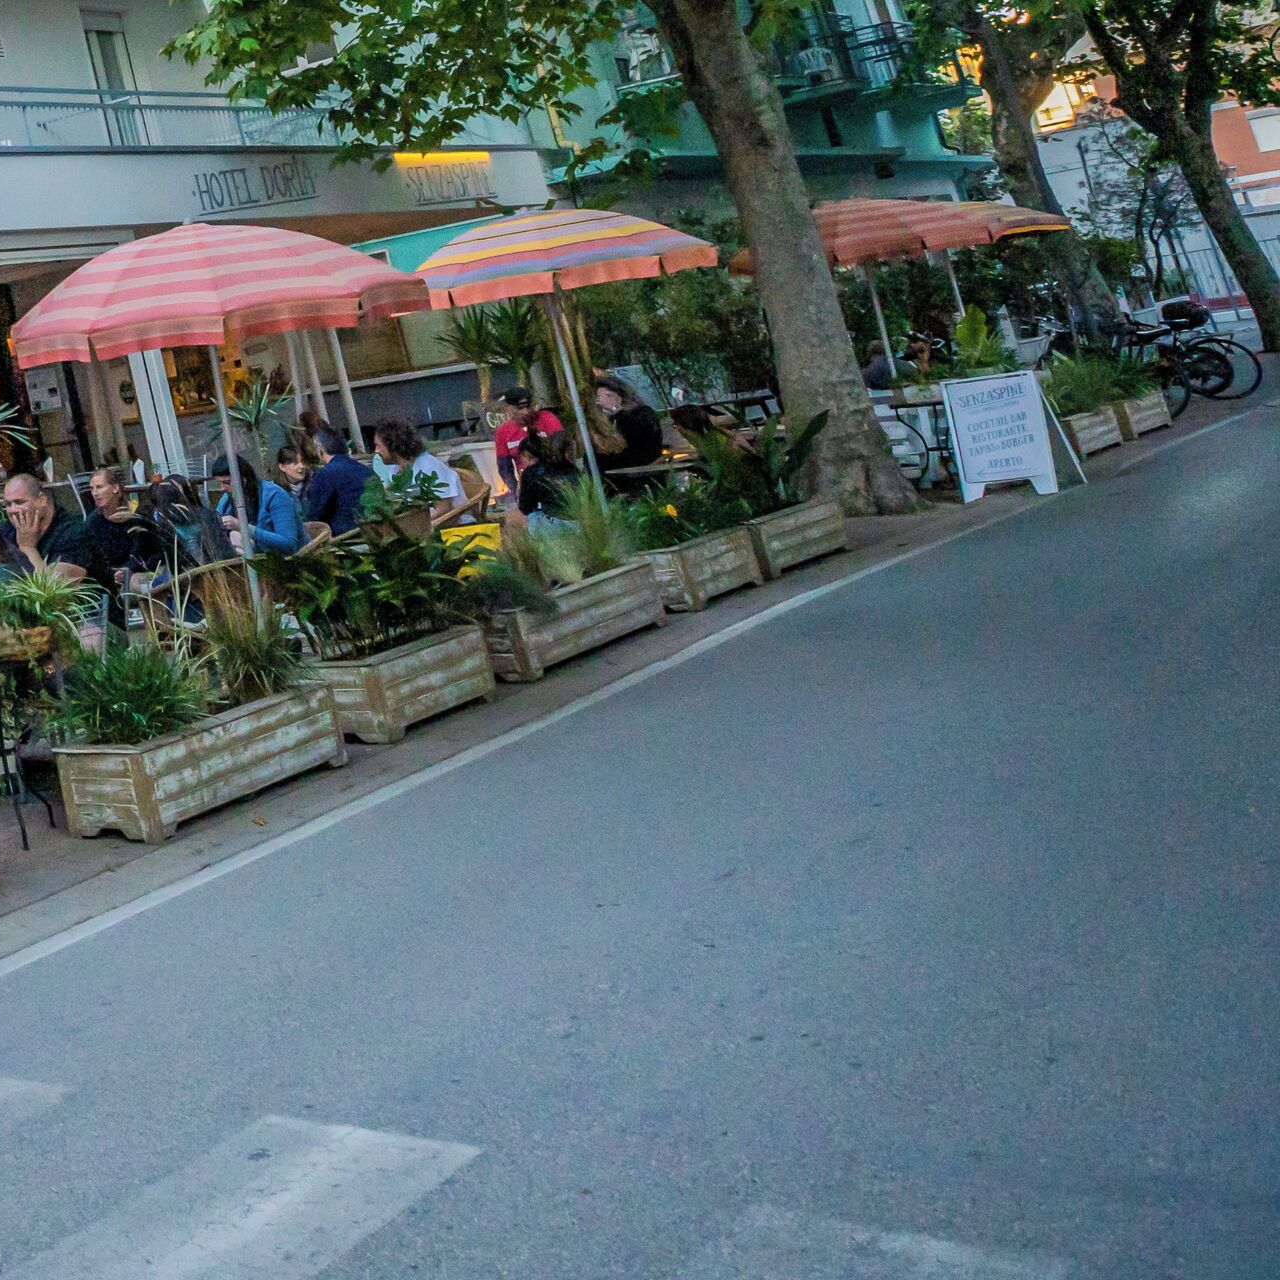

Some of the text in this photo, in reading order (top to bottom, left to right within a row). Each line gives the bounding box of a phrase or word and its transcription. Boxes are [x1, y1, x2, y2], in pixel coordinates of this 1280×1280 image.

[194, 167, 260, 211] HOTEL
[958, 382, 1025, 409] SENZASPINE
[971, 423, 1027, 444] RISTORANTE
[988, 456, 1023, 469] APERTO
